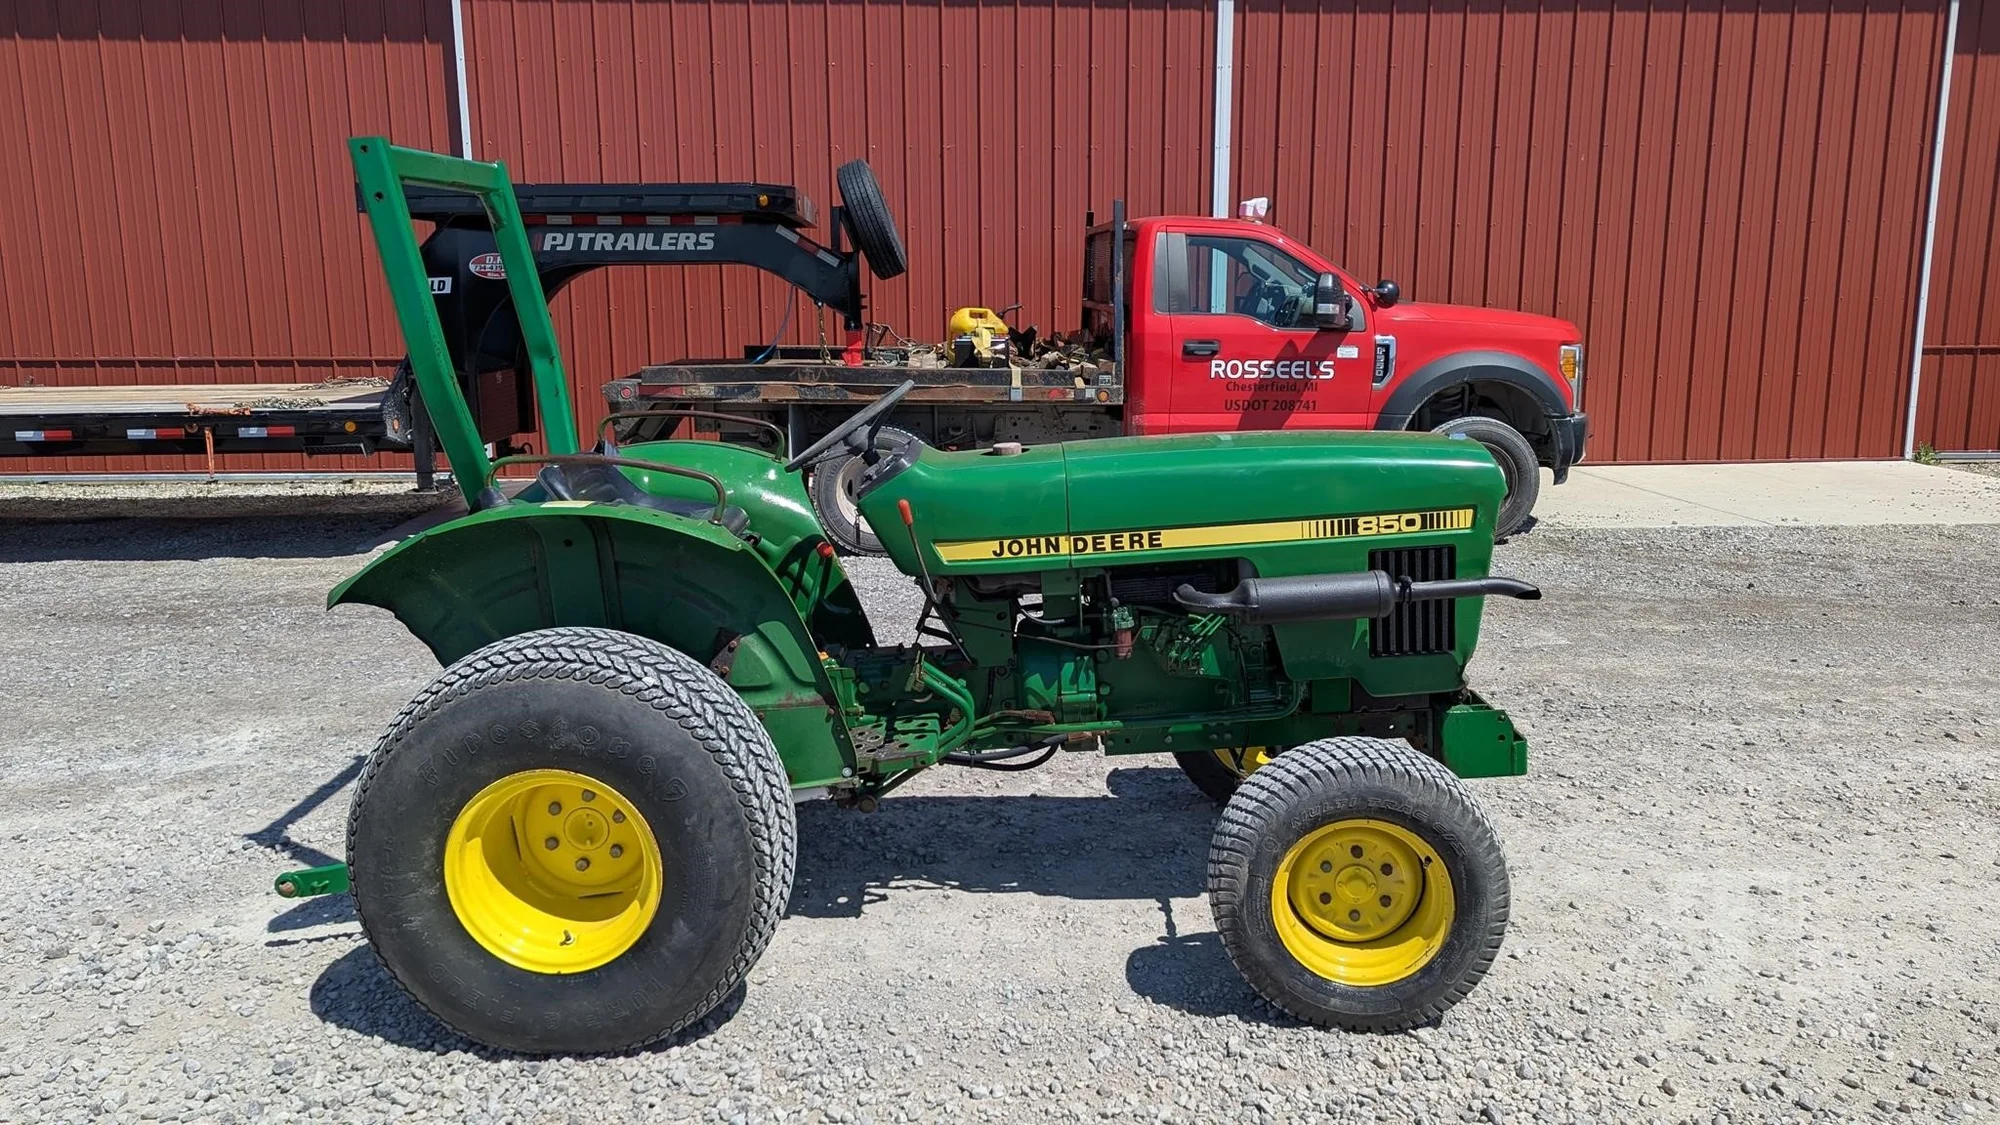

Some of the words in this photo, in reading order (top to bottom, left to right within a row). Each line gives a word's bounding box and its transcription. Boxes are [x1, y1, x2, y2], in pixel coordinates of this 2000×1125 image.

[543, 233, 574, 250] PJ
[577, 233, 715, 250] TRAILERS
[1210, 359, 1336, 380] ROSSEEL'S
[1225, 381, 1300, 393] Chesterfield,
[1304, 382, 1318, 392] MI
[1224, 400, 1268, 411] USDOT
[1273, 400, 1317, 411] 208741
[1357, 513, 1422, 535] 850
[992, 536, 1060, 558] JOHN
[1072, 531, 1163, 554] DEERE
